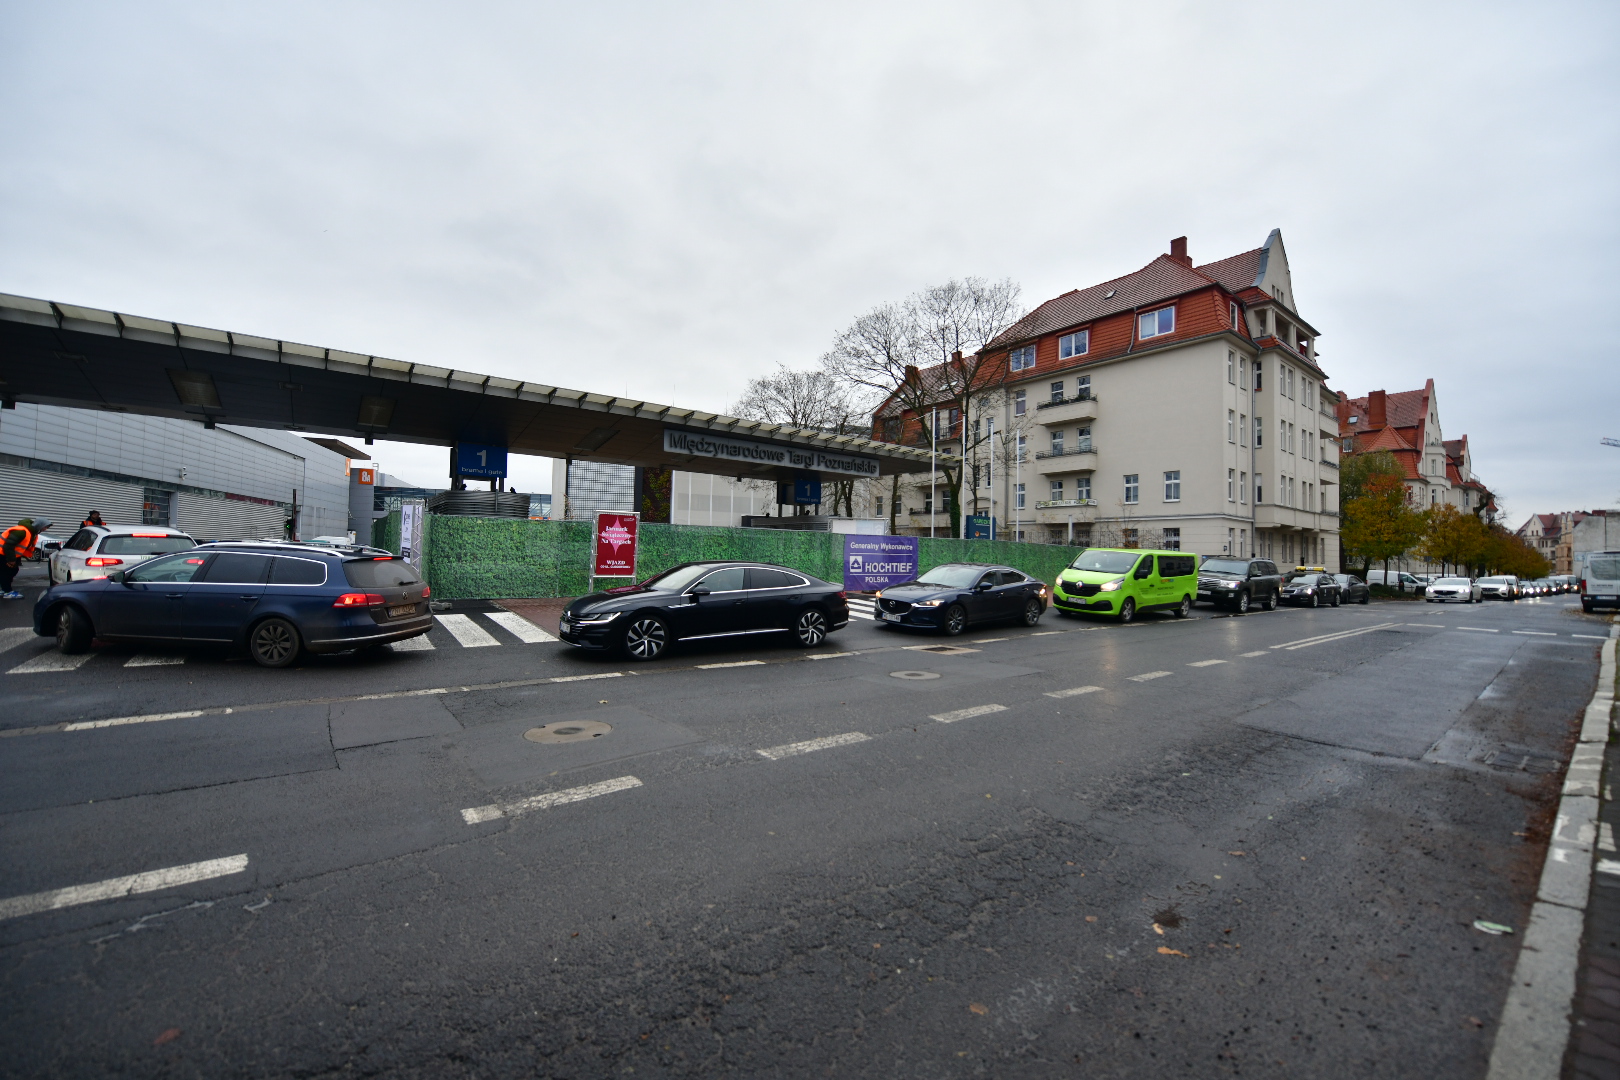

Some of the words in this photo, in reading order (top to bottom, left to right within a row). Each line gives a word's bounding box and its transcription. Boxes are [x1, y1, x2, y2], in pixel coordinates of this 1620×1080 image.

[477, 449, 487, 467] 1
[669, 432, 785, 462] Międzynarodowe
[787, 449, 815, 469] Targi
[817, 453, 878, 474] Poznańskie
[804, 483, 811, 497] 1
[850, 541, 880, 551] Generalny
[880, 542, 913, 551] Wykonawce
[865, 562, 913, 573] HOCHTIEF
